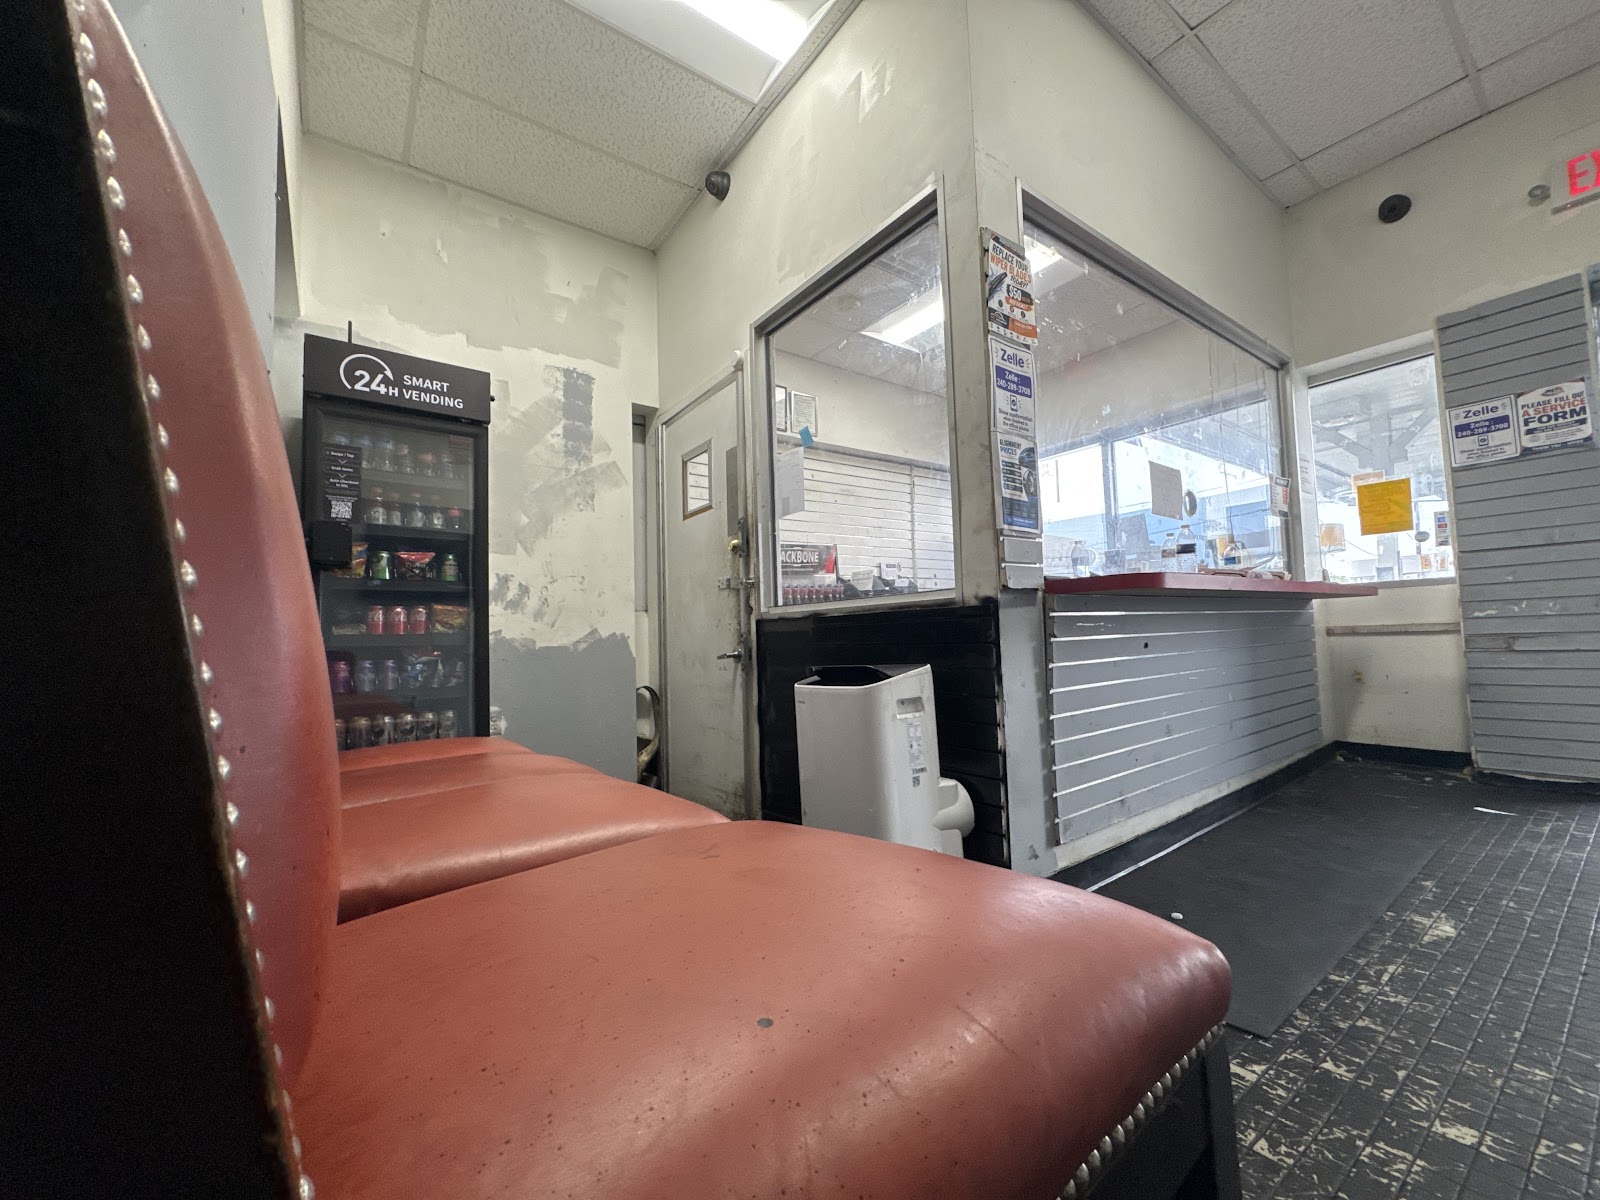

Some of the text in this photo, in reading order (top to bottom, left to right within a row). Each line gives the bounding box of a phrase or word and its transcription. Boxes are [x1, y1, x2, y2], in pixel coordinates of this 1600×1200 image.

[992, 243, 1029, 273] REPLACE YOUR
[990, 253, 1032, 284] WIPER BLADES
[1009, 284, 1022, 302] $50
[1001, 348, 1025, 368] Zelle
[403, 375, 450, 393] SMART
[996, 377, 1031, 396] 240-289-3708
[402, 388, 464, 409] VENDING
[1521, 399, 1552, 410] PLEASE
[1554, 395, 1570, 403] FILL
[1522, 397, 1586, 418] A SERVICE
[1463, 405, 1499, 419] Zelle
[1523, 405, 1587, 427] FORM
[1457, 422, 1509, 438] 240-289-3708
[1470, 420, 1490, 429] Zelle
[1000, 446, 1018, 456] PRICES
